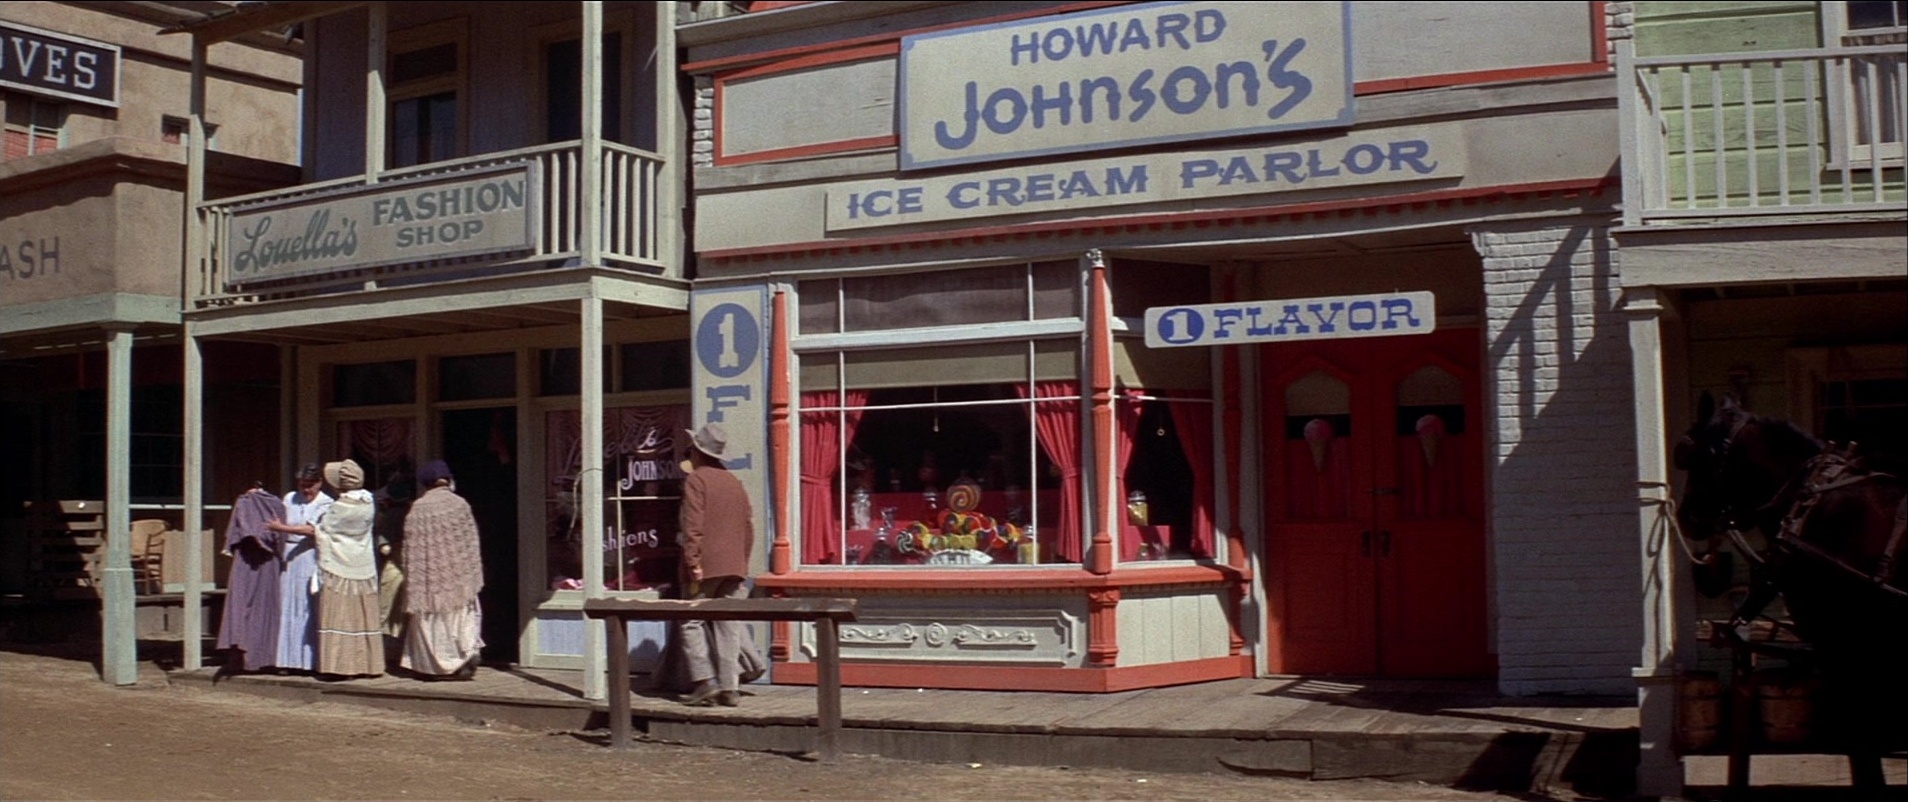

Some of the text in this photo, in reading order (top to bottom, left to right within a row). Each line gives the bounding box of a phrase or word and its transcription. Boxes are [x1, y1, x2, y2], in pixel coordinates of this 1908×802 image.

[0, 36, 97, 90] VES
[1010, 9, 1227, 66] HOWARD
[372, 178, 526, 227] FASHION
[847, 139, 1438, 219] ICE CREAM PARLOR
[233, 208, 358, 274] Louella's
[395, 219, 484, 249] SHOP
[1212, 297, 1421, 339] FLAVOR
